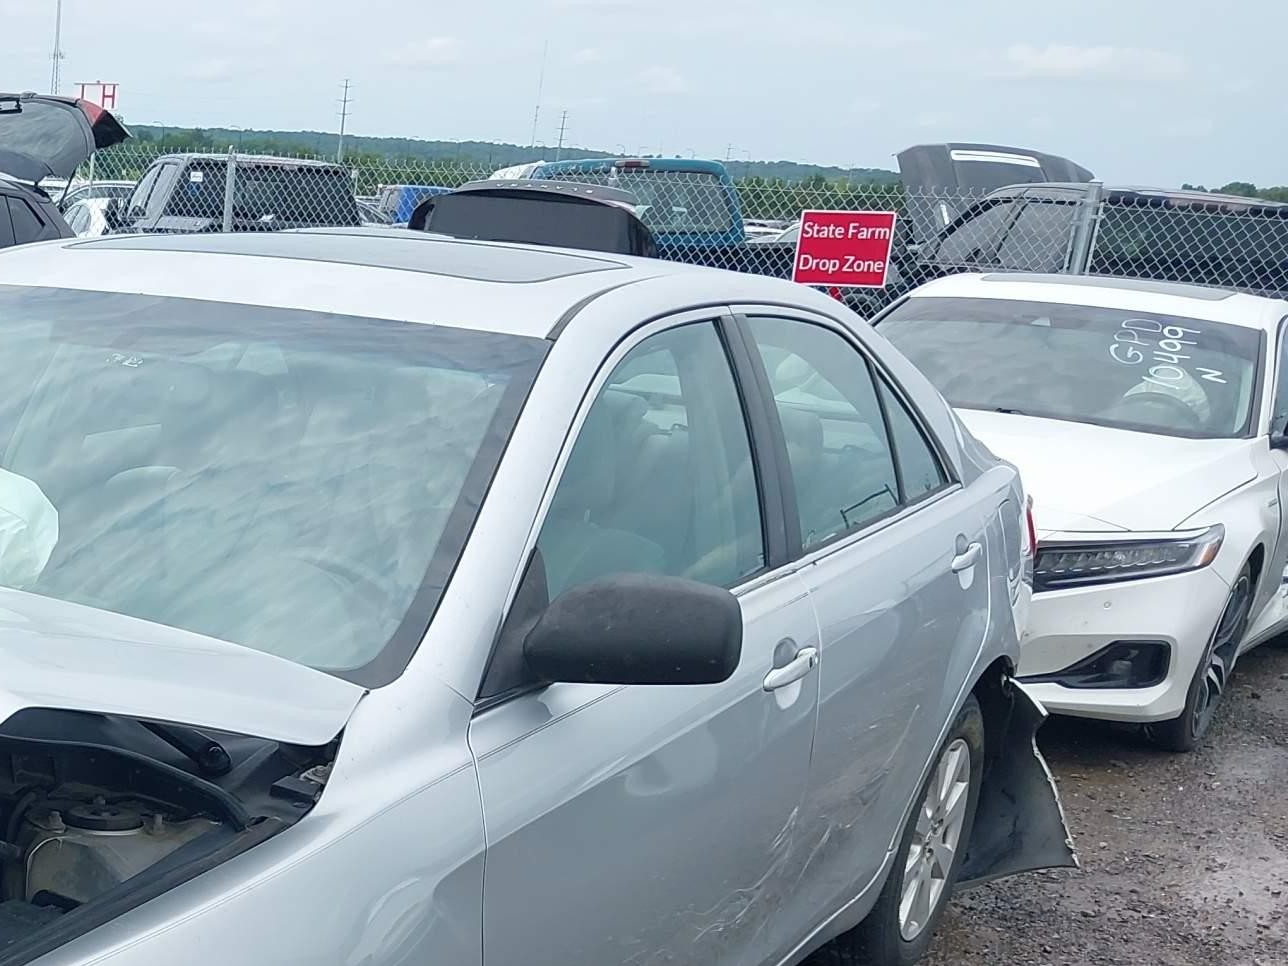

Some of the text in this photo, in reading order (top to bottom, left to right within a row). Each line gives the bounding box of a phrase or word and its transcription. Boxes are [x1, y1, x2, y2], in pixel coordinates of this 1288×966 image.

[802, 221, 890, 240] State Farm
[798, 254, 885, 274] Drop Zone
[1109, 318, 1162, 365] GPD
[1142, 325, 1201, 390] 10499
